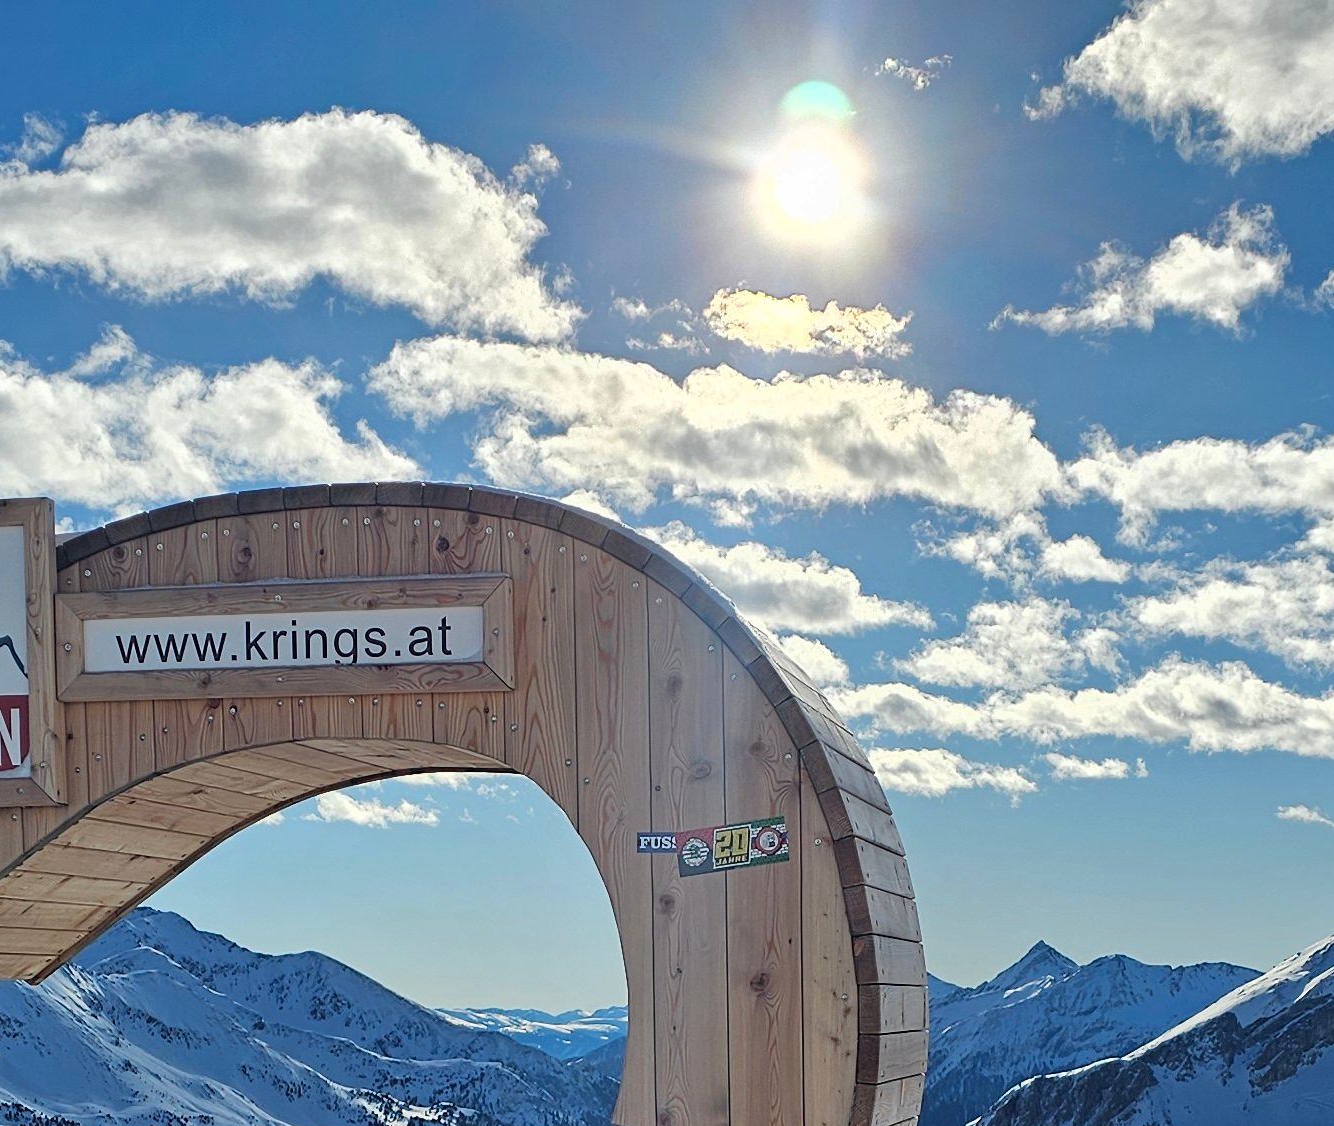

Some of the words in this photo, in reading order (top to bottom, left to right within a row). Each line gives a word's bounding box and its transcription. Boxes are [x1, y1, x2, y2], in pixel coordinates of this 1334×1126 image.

[115, 615, 453, 665] www.krings.at
[715, 827, 748, 858] 20
[715, 855, 748, 866] JAHRE
